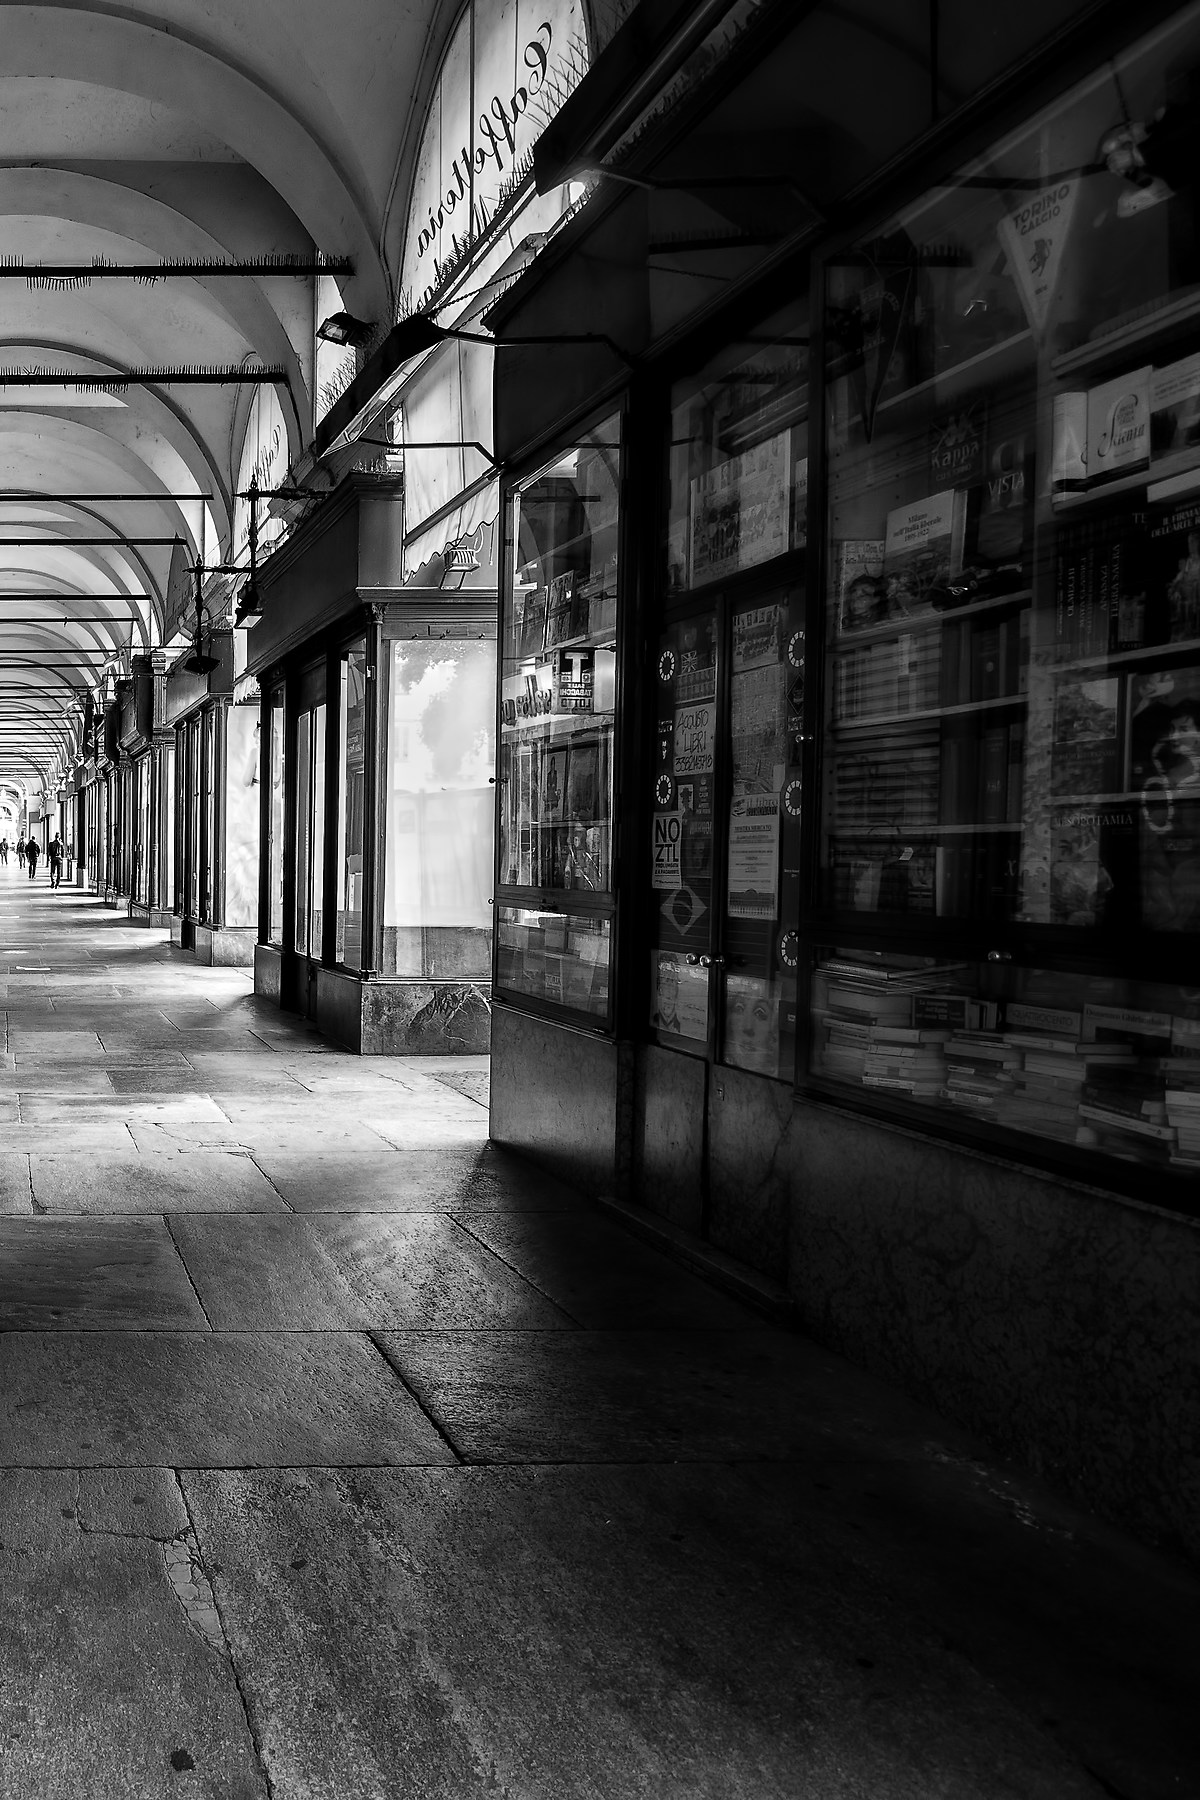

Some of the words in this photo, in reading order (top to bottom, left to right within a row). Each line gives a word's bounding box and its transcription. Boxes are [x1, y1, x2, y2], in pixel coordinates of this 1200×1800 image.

[1013, 184, 1070, 229] TORINO
[1021, 205, 1061, 236] CALCIO
[931, 441, 980, 468] Kappa
[988, 472, 1025, 495] VISTA
[1111, 544, 1121, 580] SACRA
[1099, 564, 1108, 611] ANASAZI
[1111, 582, 1120, 617] TERRA
[677, 708, 709, 730] ACQUISTO
[684, 731, 707, 753] LIBRI
[655, 818, 680, 843] NO
[1054, 813, 1133, 827] MESOPOTAMIA
[655, 844, 679, 862] ZTL
[1012, 1009, 1073, 1027] QUATTROCENTO
